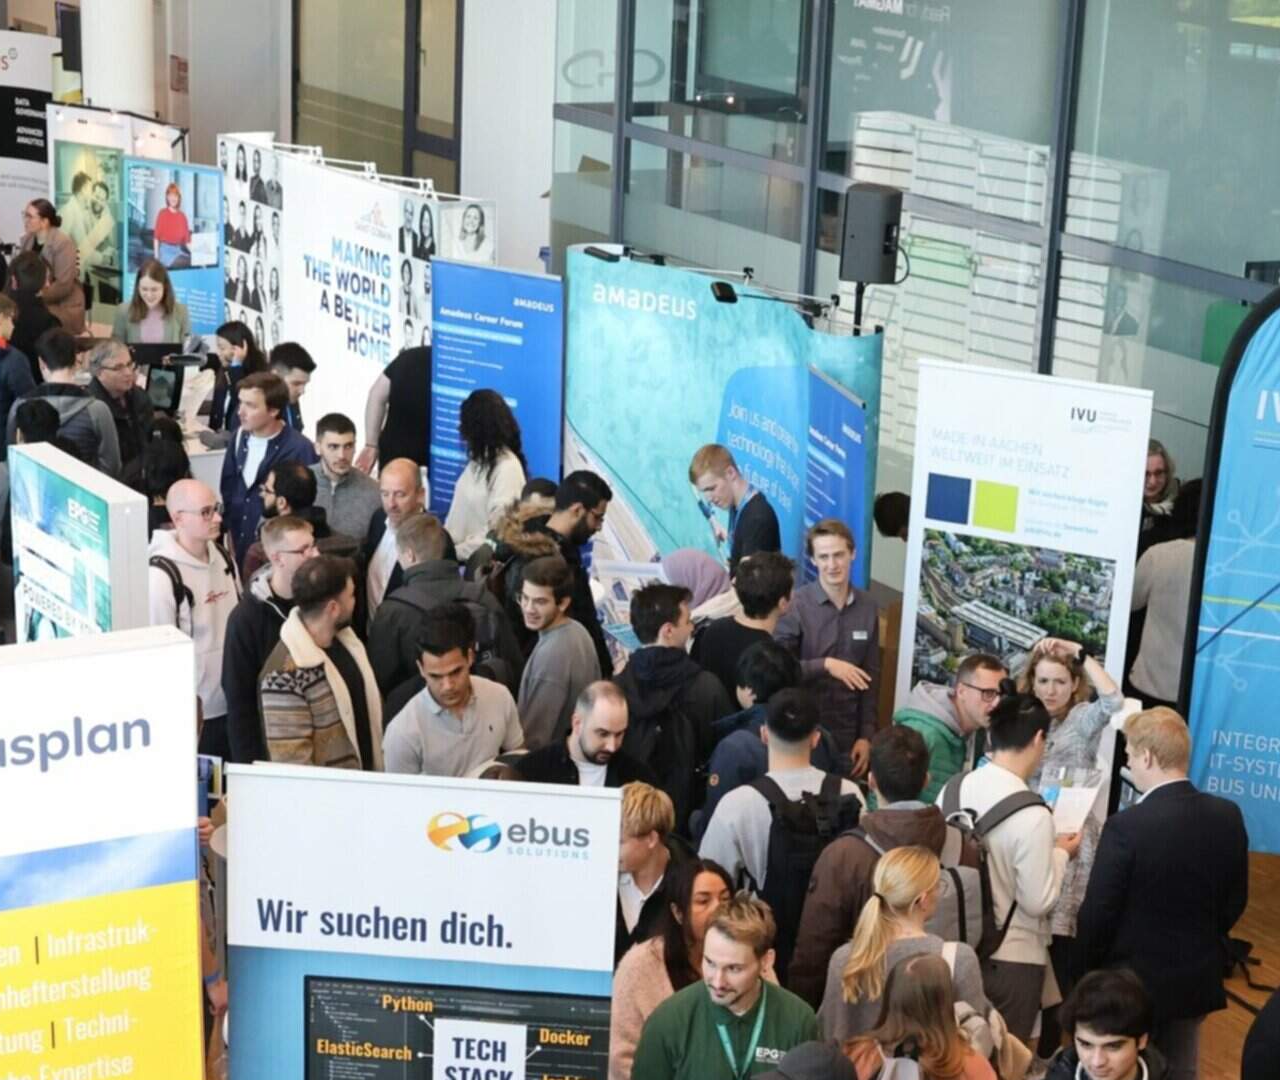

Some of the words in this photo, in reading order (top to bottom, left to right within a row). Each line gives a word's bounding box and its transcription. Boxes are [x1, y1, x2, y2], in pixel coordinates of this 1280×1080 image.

[15, 107, 46, 119] GOVERNANC
[331, 236, 391, 279] MAKING
[303, 253, 331, 286] THE
[335, 267, 391, 308] WORLD
[320, 289, 330, 314] A
[334, 293, 391, 338] BETTER
[347, 327, 391, 366] HOME
[1071, 407, 1098, 423] IVU
[931, 427, 969, 445] MADE
[930, 446, 995, 466] WELTWEIT
[1016, 458, 1071, 479] EINSATZ
[1207, 776, 1245, 797] BUS
[507, 817, 590, 849] ebus
[506, 846, 590, 861] SOLUTIONS
[46, 915, 158, 959] Infrastruk-
[257, 898, 309, 935] Wir
[319, 905, 428, 943] suchen
[440, 911, 513, 949] dich.
[382, 993, 433, 1014] Python
[64, 1010, 139, 1042] Techni-
[539, 1028, 591, 1048] Docker
[316, 1039, 412, 1062] ElasticSearch
[452, 1037, 507, 1063] TECH
